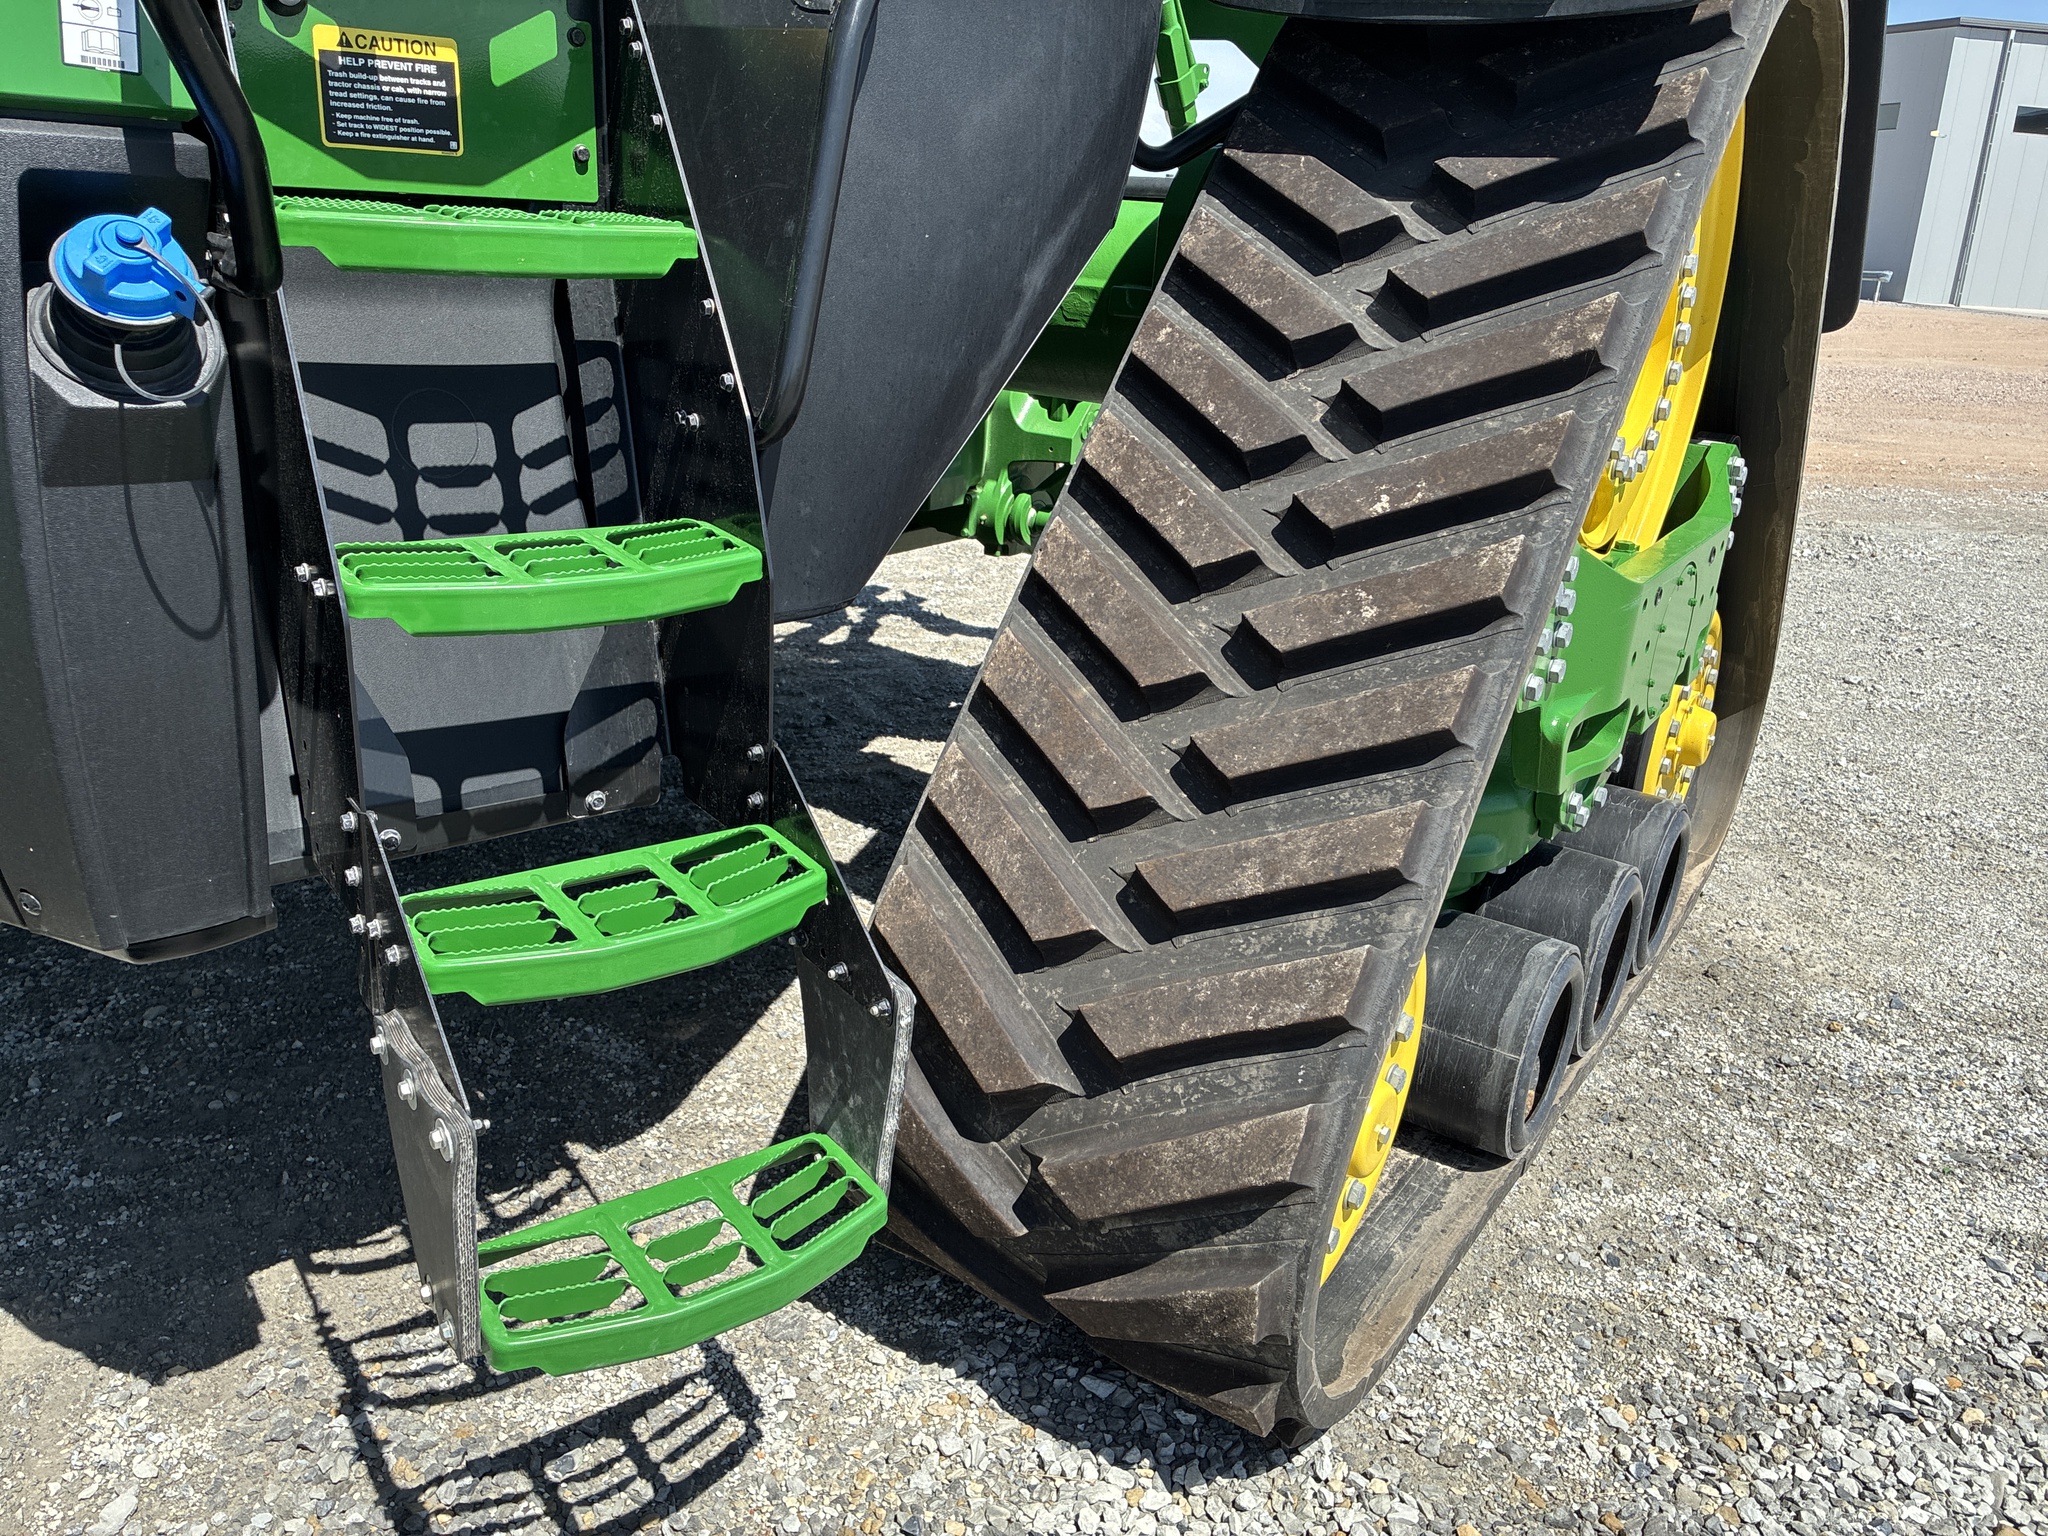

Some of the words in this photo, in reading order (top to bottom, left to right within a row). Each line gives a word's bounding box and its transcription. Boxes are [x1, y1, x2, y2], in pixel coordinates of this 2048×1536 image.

[355, 34, 436, 56] CAUTION
[338, 56, 365, 66] HELP
[368, 59, 413, 71] PREVENT
[415, 63, 437, 74] FIRE
[349, 72, 378, 81] build-up
[379, 74, 409, 83] between
[349, 92, 379, 101] settings,
[330, 100, 364, 108] increased
[366, 103, 393, 111] friction.
